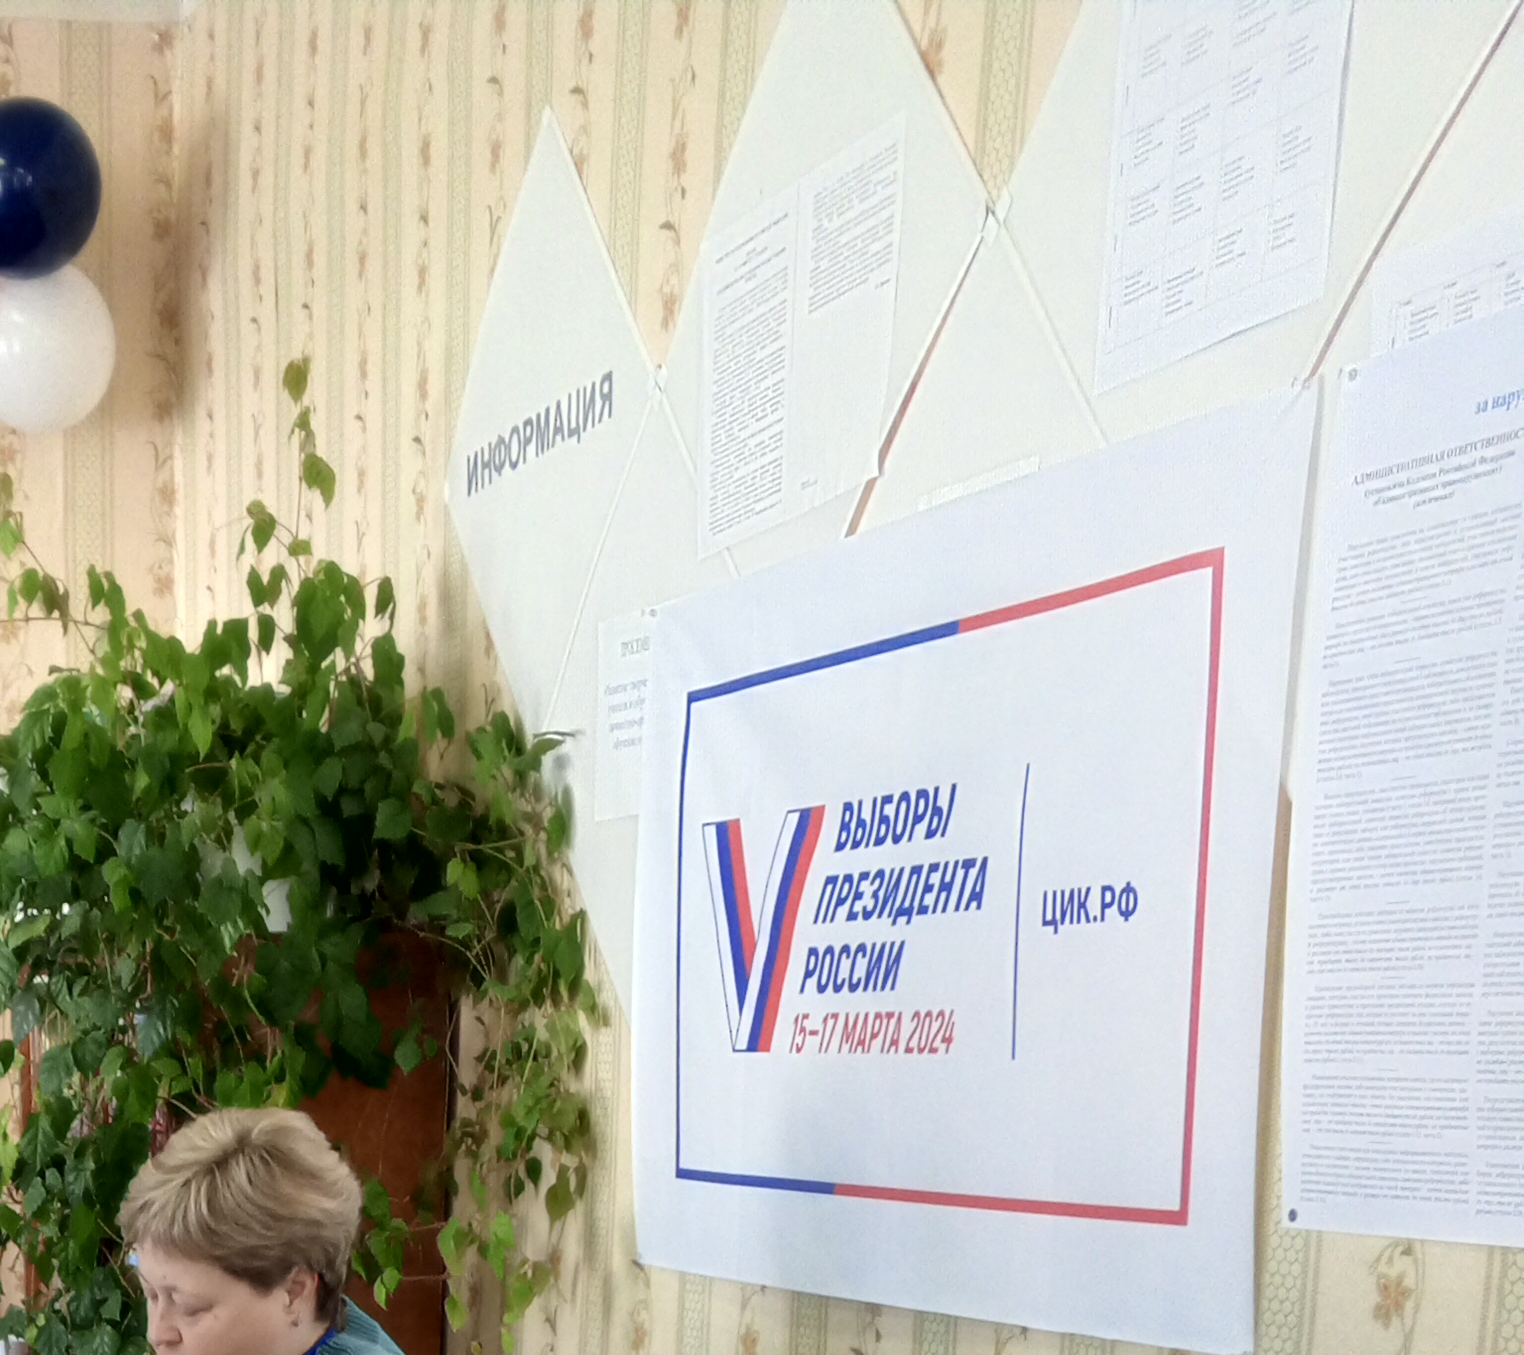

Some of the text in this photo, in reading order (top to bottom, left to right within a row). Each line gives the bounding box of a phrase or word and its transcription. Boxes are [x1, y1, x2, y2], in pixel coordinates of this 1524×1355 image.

[466, 370, 613, 498] ИНФОРМАЦИЯ
[834, 782, 958, 853] ВЫБОРЫ
[812, 856, 989, 926] ПРЕЗИДЕНТА
[1041, 881, 1138, 935] ЦИК.РФ
[798, 940, 906, 995] РОССИИ
[837, 1011, 903, 1055] МАРТА
[904, 1009, 956, 1055] 2024
